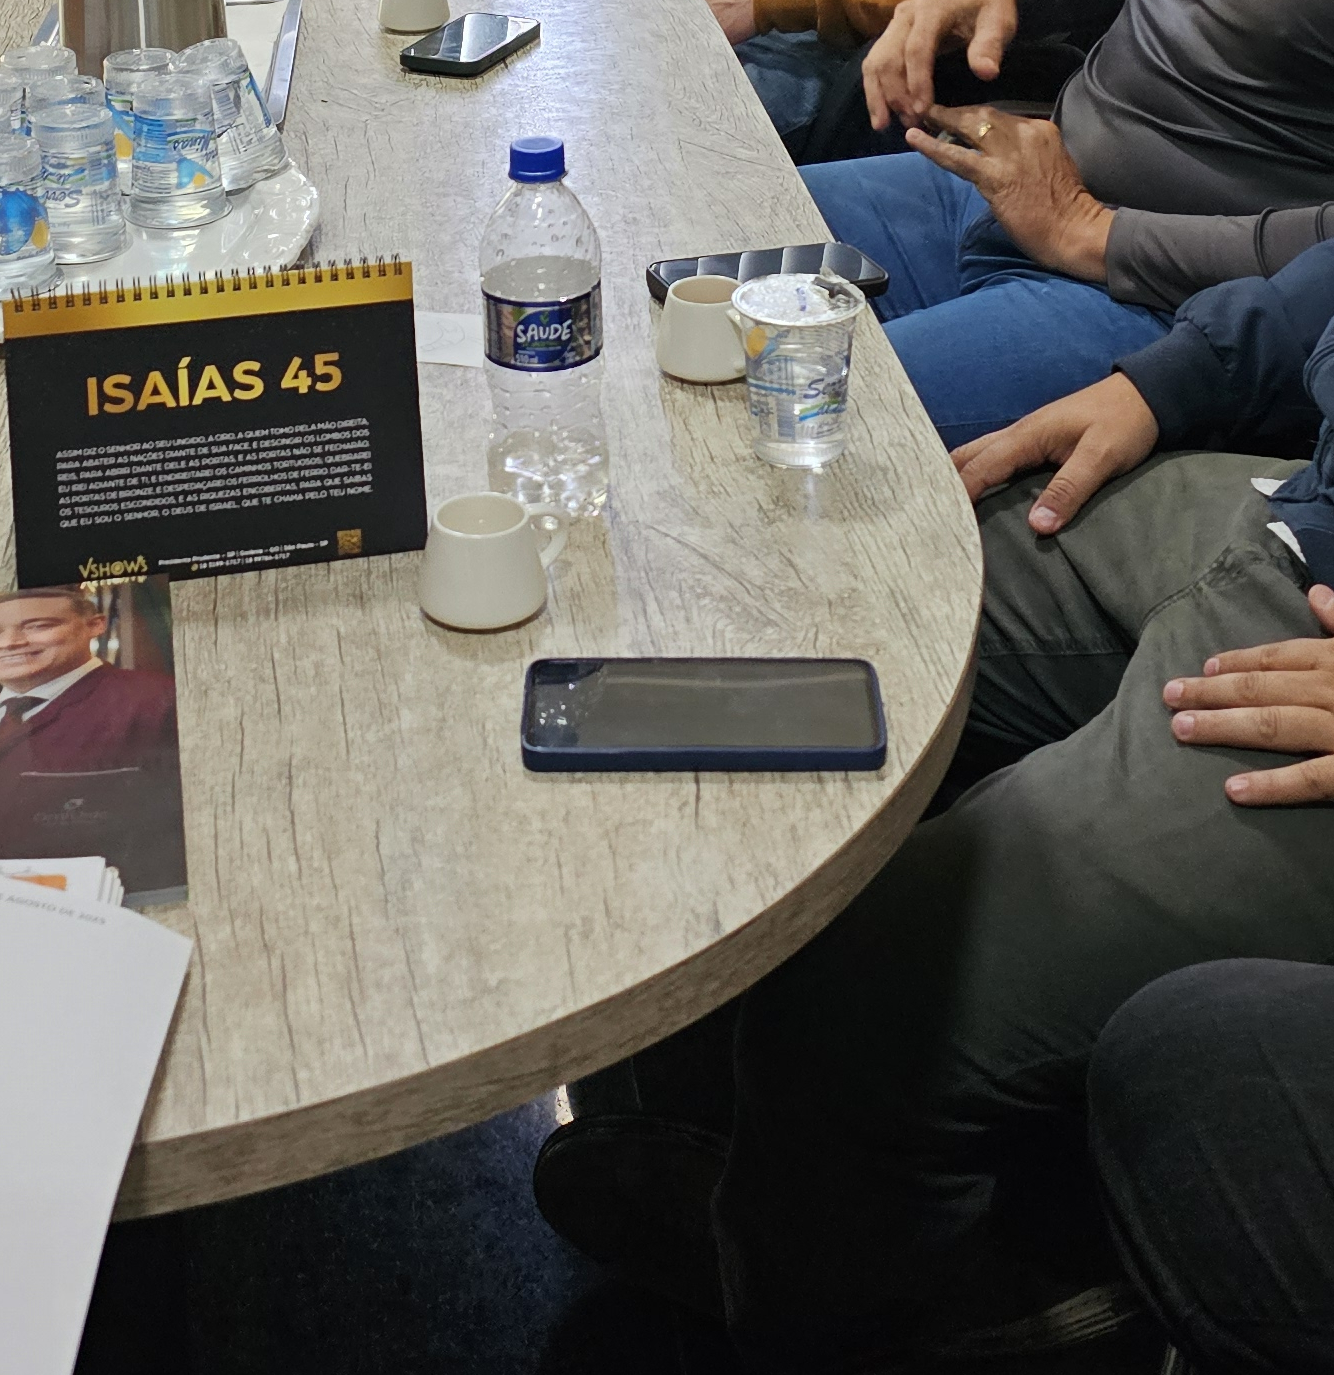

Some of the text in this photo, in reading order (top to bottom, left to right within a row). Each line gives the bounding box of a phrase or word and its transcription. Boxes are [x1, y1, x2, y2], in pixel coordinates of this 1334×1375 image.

[87, 352, 343, 416] ISAÍAS 45
[56, 450, 82, 459] ASSIM
[83, 448, 97, 456] DIZ
[106, 443, 141, 453] SENHOR
[155, 440, 171, 448] SEU
[244, 429, 268, 438] QUEM
[295, 424, 316, 433] PELA
[317, 421, 336, 430] MÃO
[57, 461, 80, 470] PARA
[130, 451, 163, 463] NAÇÕES
[165, 449, 196, 458] DIANTE
[211, 445, 227, 453] SUA
[303, 435, 315, 443] OS
[352, 429, 370, 437] DOS
[58, 485, 70, 493] EU
[89, 479, 125, 489] ADIANTE
[215, 468, 227, 476] OS
[80, 470, 103, 479] PARA
[131, 464, 162, 473] DIANTE
[164, 461, 186, 470] DELE
[246, 453, 257, 461] AS
[259, 449, 291, 459] PORTAS
[293, 446, 311, 455] NÃO
[59, 508, 72, 516] OS
[299, 480, 322, 489] PARA
[323, 478, 341, 486] QUE
[59, 519, 78, 528] QUE
[80, 517, 92, 525] EU
[94, 515, 112, 524] SOU
[171, 506, 193, 515] DEUS
[195, 504, 208, 512] DE
[241, 498, 259, 507] QUE
[262, 497, 272, 505] TE
[274, 493, 303, 503] CHAMA
[304, 491, 327, 500] PELO
[329, 489, 345, 497] TEU
[71, 493, 105, 503] PORTAS
[58, 906, 75, 917] DE
